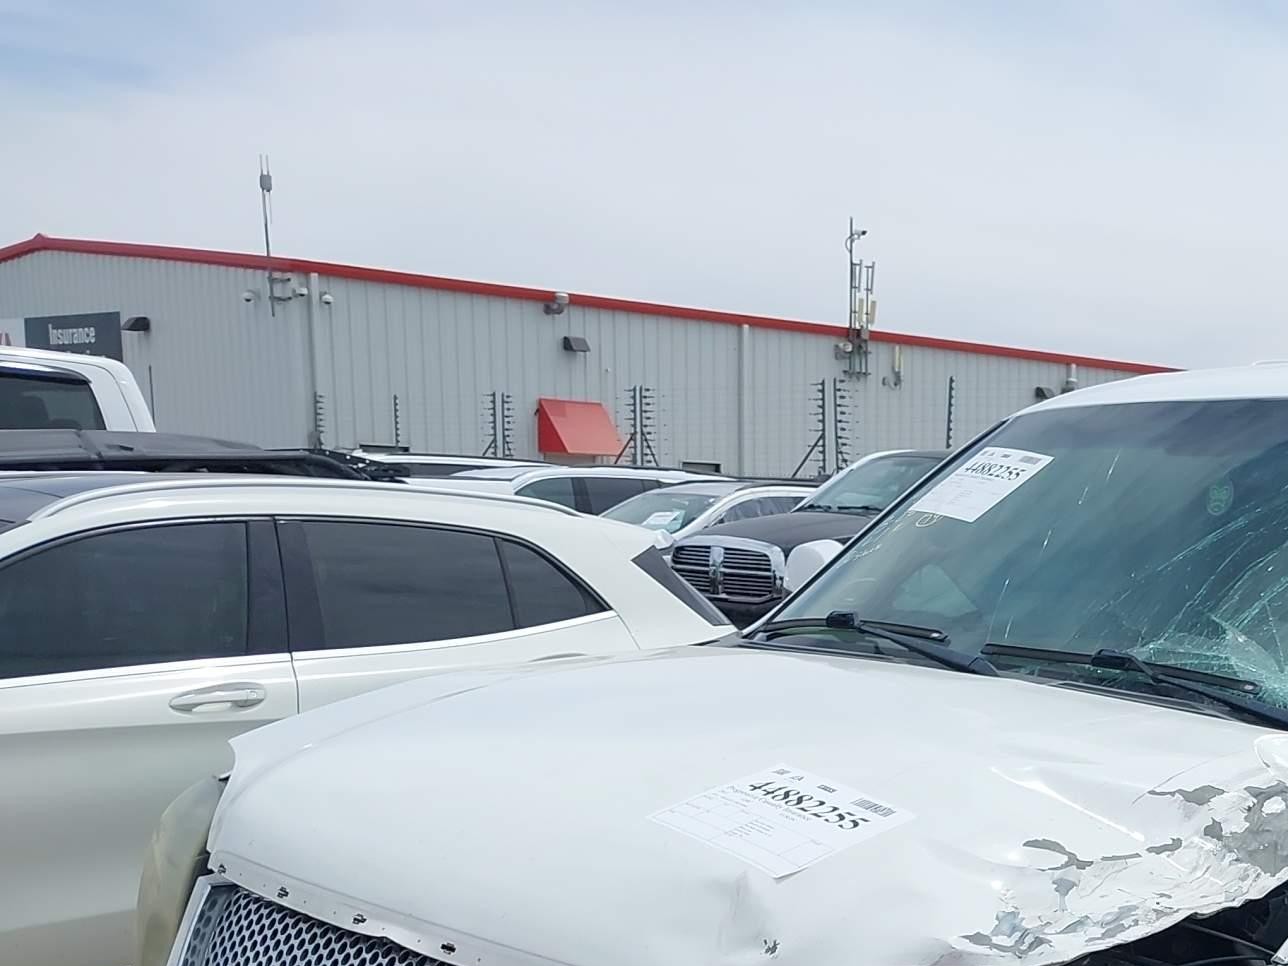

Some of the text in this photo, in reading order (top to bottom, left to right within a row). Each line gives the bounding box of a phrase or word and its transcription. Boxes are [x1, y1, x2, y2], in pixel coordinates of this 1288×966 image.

[49, 325, 96, 345] Insurance
[966, 461, 1026, 480] 44882255
[749, 781, 871, 830] 44882255
